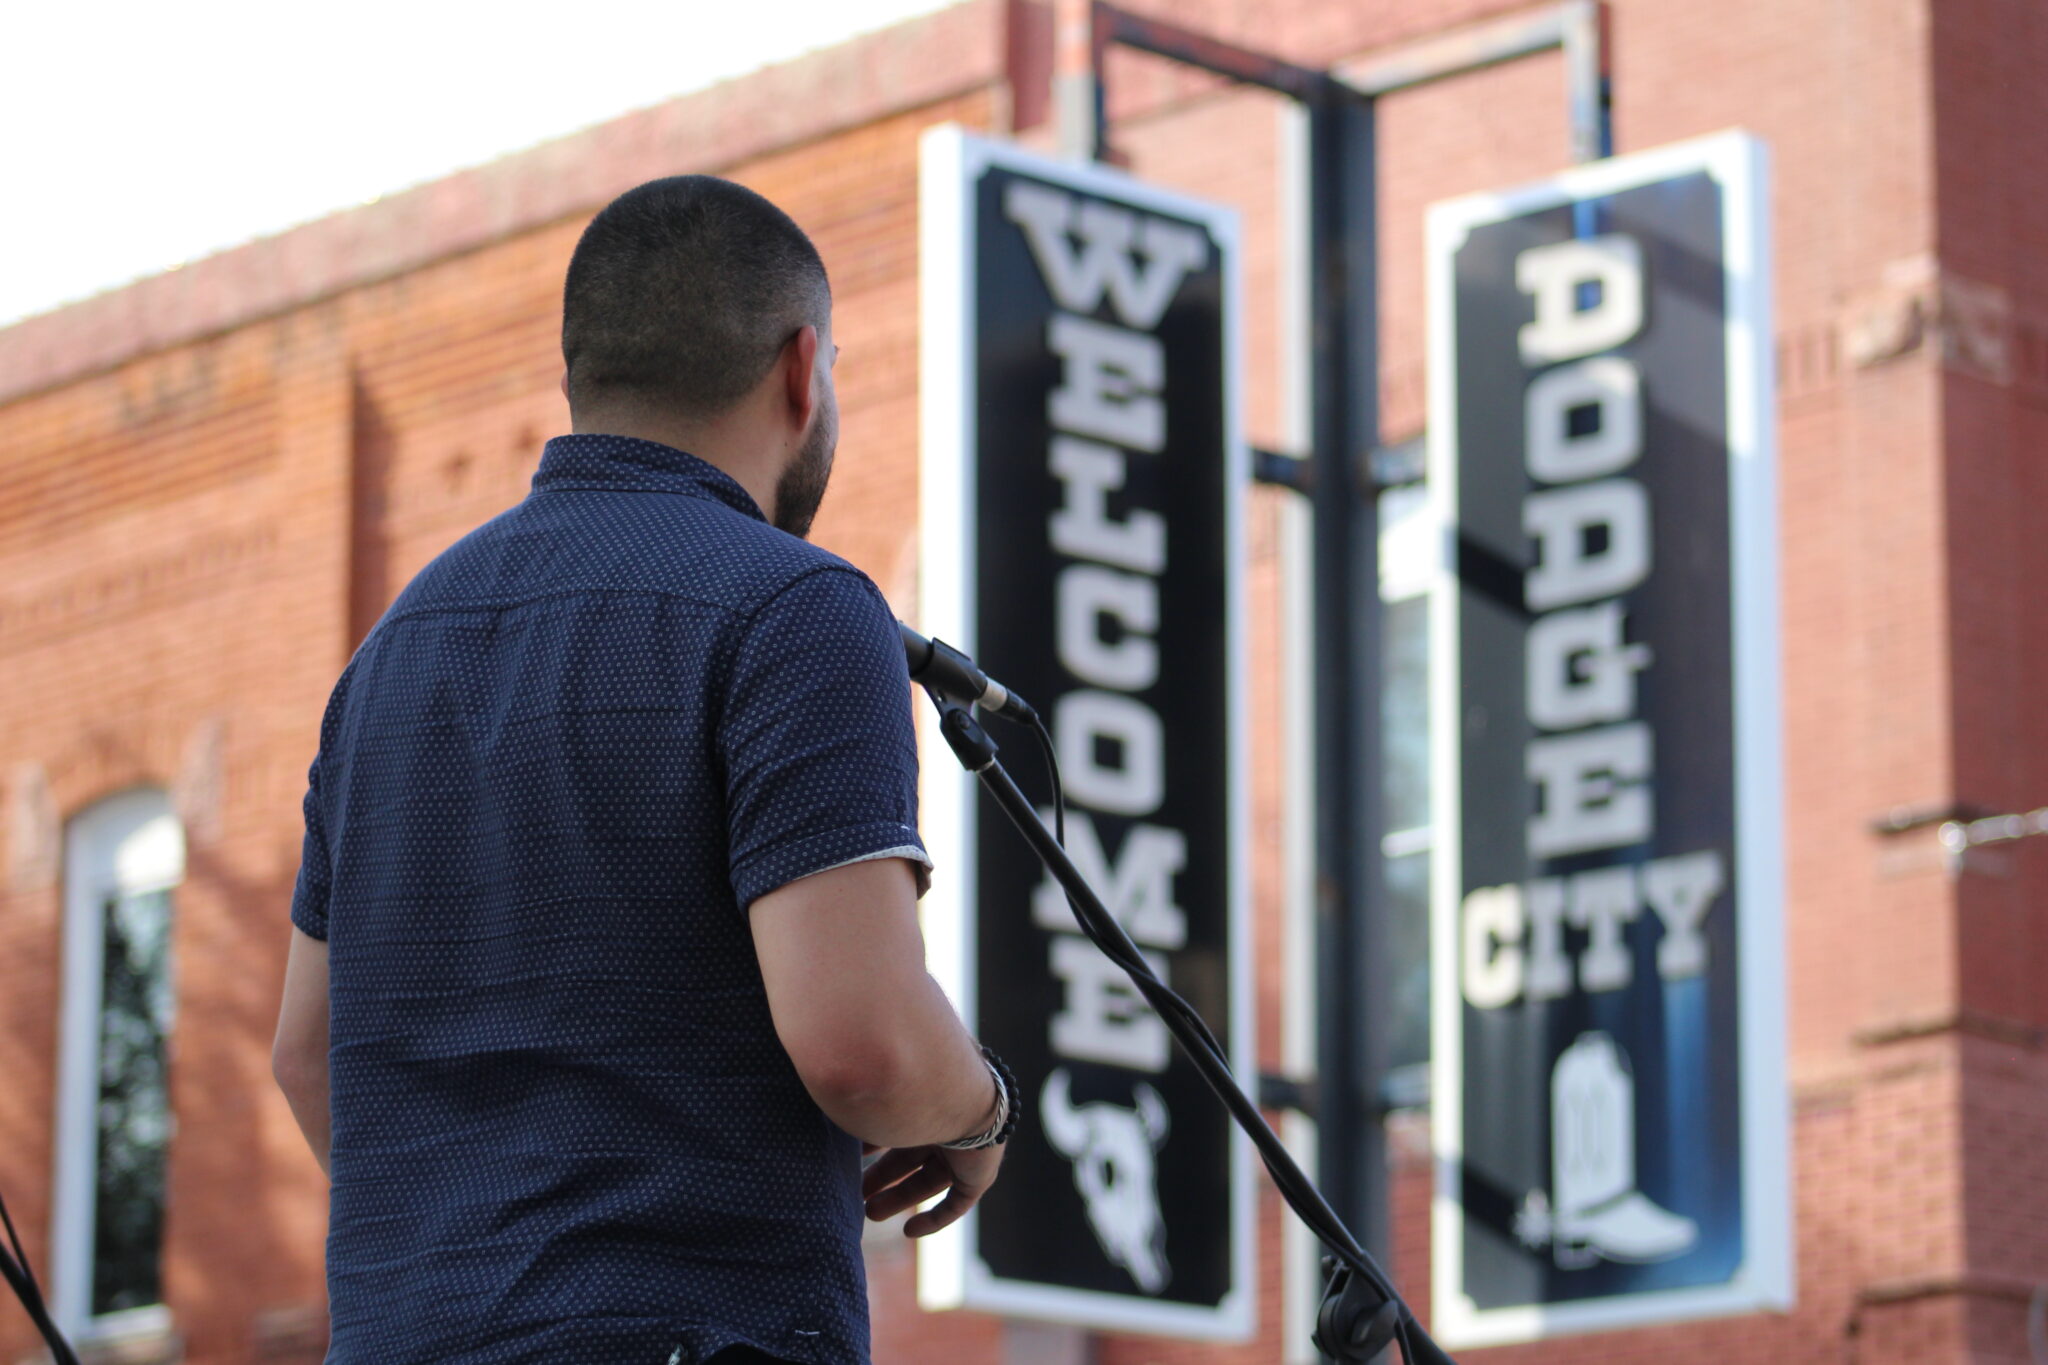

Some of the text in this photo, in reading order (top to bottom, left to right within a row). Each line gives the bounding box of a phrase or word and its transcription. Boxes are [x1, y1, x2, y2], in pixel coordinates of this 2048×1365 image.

[1003, 181, 1208, 1074] WELCOME
[1515, 233, 1655, 860] DODGE
[1462, 850, 1725, 1009] CITY
